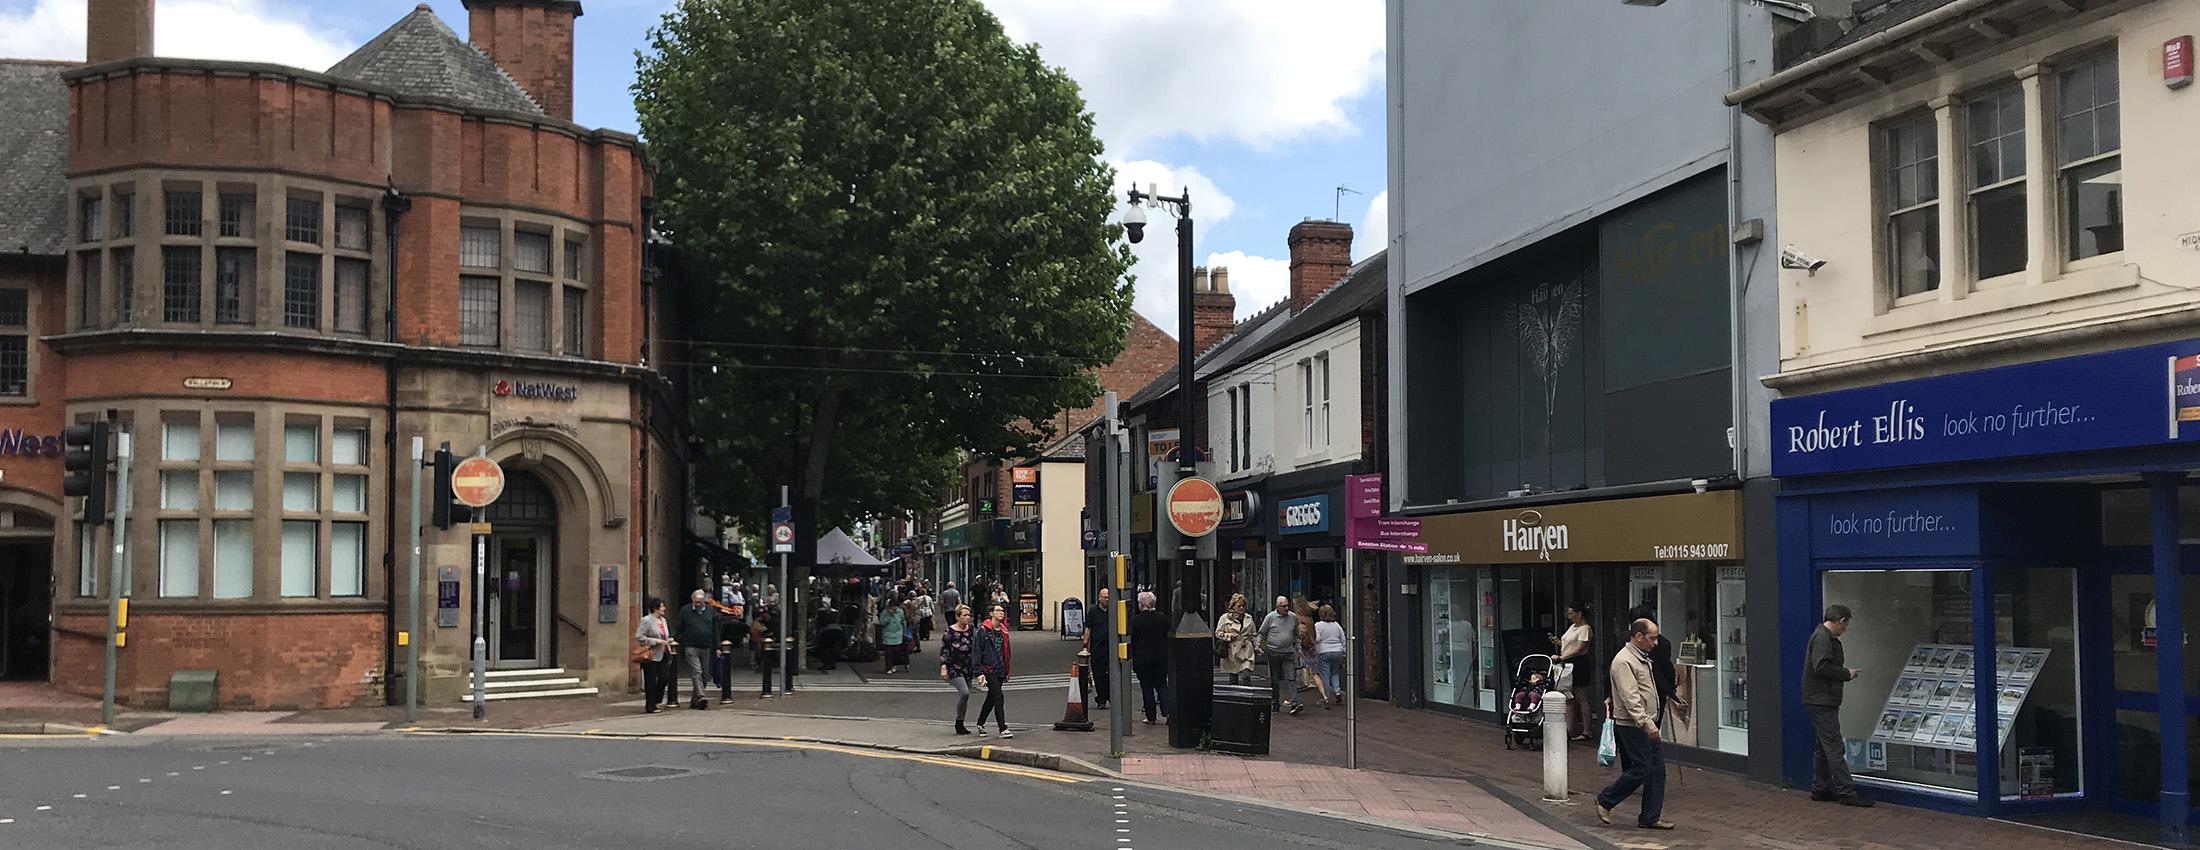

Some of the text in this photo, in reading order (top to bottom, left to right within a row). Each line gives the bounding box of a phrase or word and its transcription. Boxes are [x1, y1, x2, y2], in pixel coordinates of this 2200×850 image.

[514, 381, 577, 400] NatWest
[1788, 399, 2096, 453] Robert Ellis look no further...
[1154, 442, 1167, 452] TO
[1286, 502, 1321, 527] GREGGS
[1830, 510, 1955, 538] look no further...
[1503, 519, 1569, 561] Hairven
[1654, 543, 1729, 559] Tel:0115 943 0007
[1403, 552, 1461, 563] www.hairven-salon.co.uk
